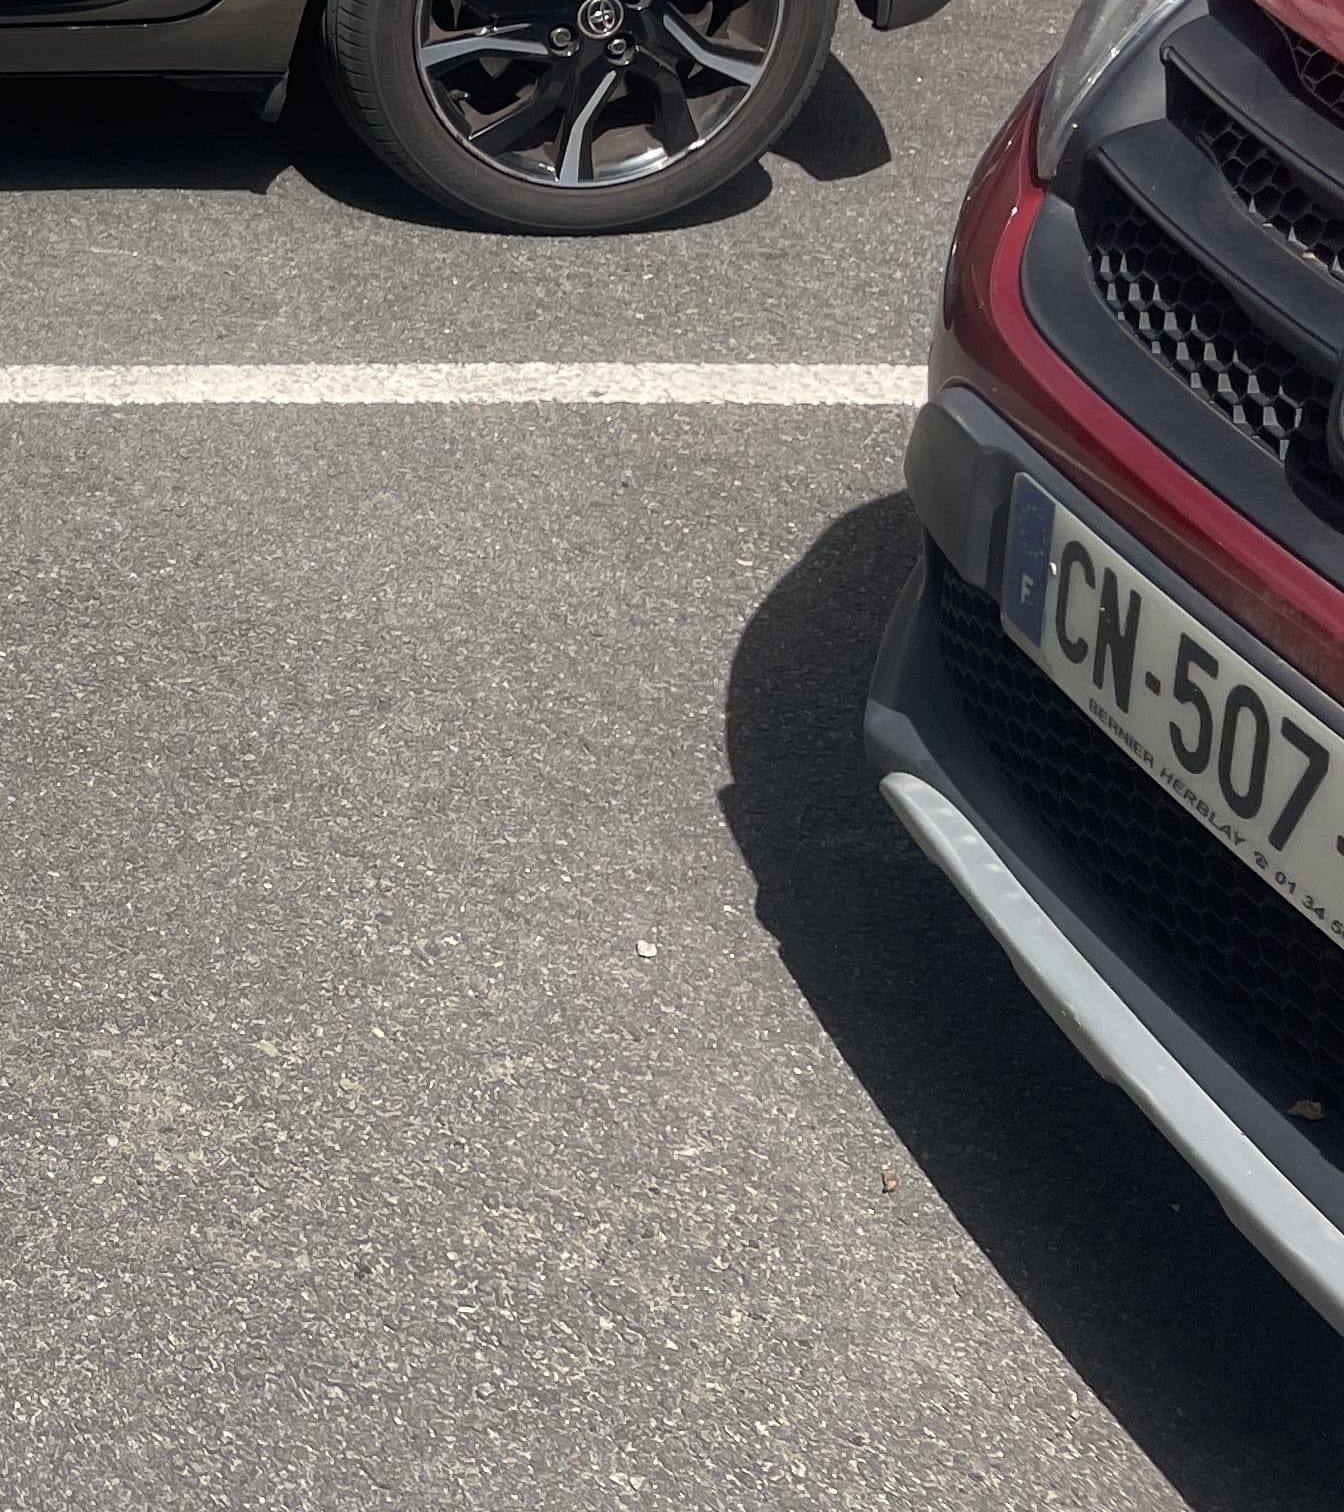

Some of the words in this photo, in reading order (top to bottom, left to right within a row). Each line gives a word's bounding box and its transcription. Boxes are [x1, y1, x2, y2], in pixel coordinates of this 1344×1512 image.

[1019, 574, 1034, 607] F
[1089, 698, 1154, 769] BERNIER
[1160, 768, 1247, 846] HERBLAY
[1275, 871, 1296, 894] 01
[1302, 895, 1325, 920] 34
[1330, 920, 1344, 939] 5
